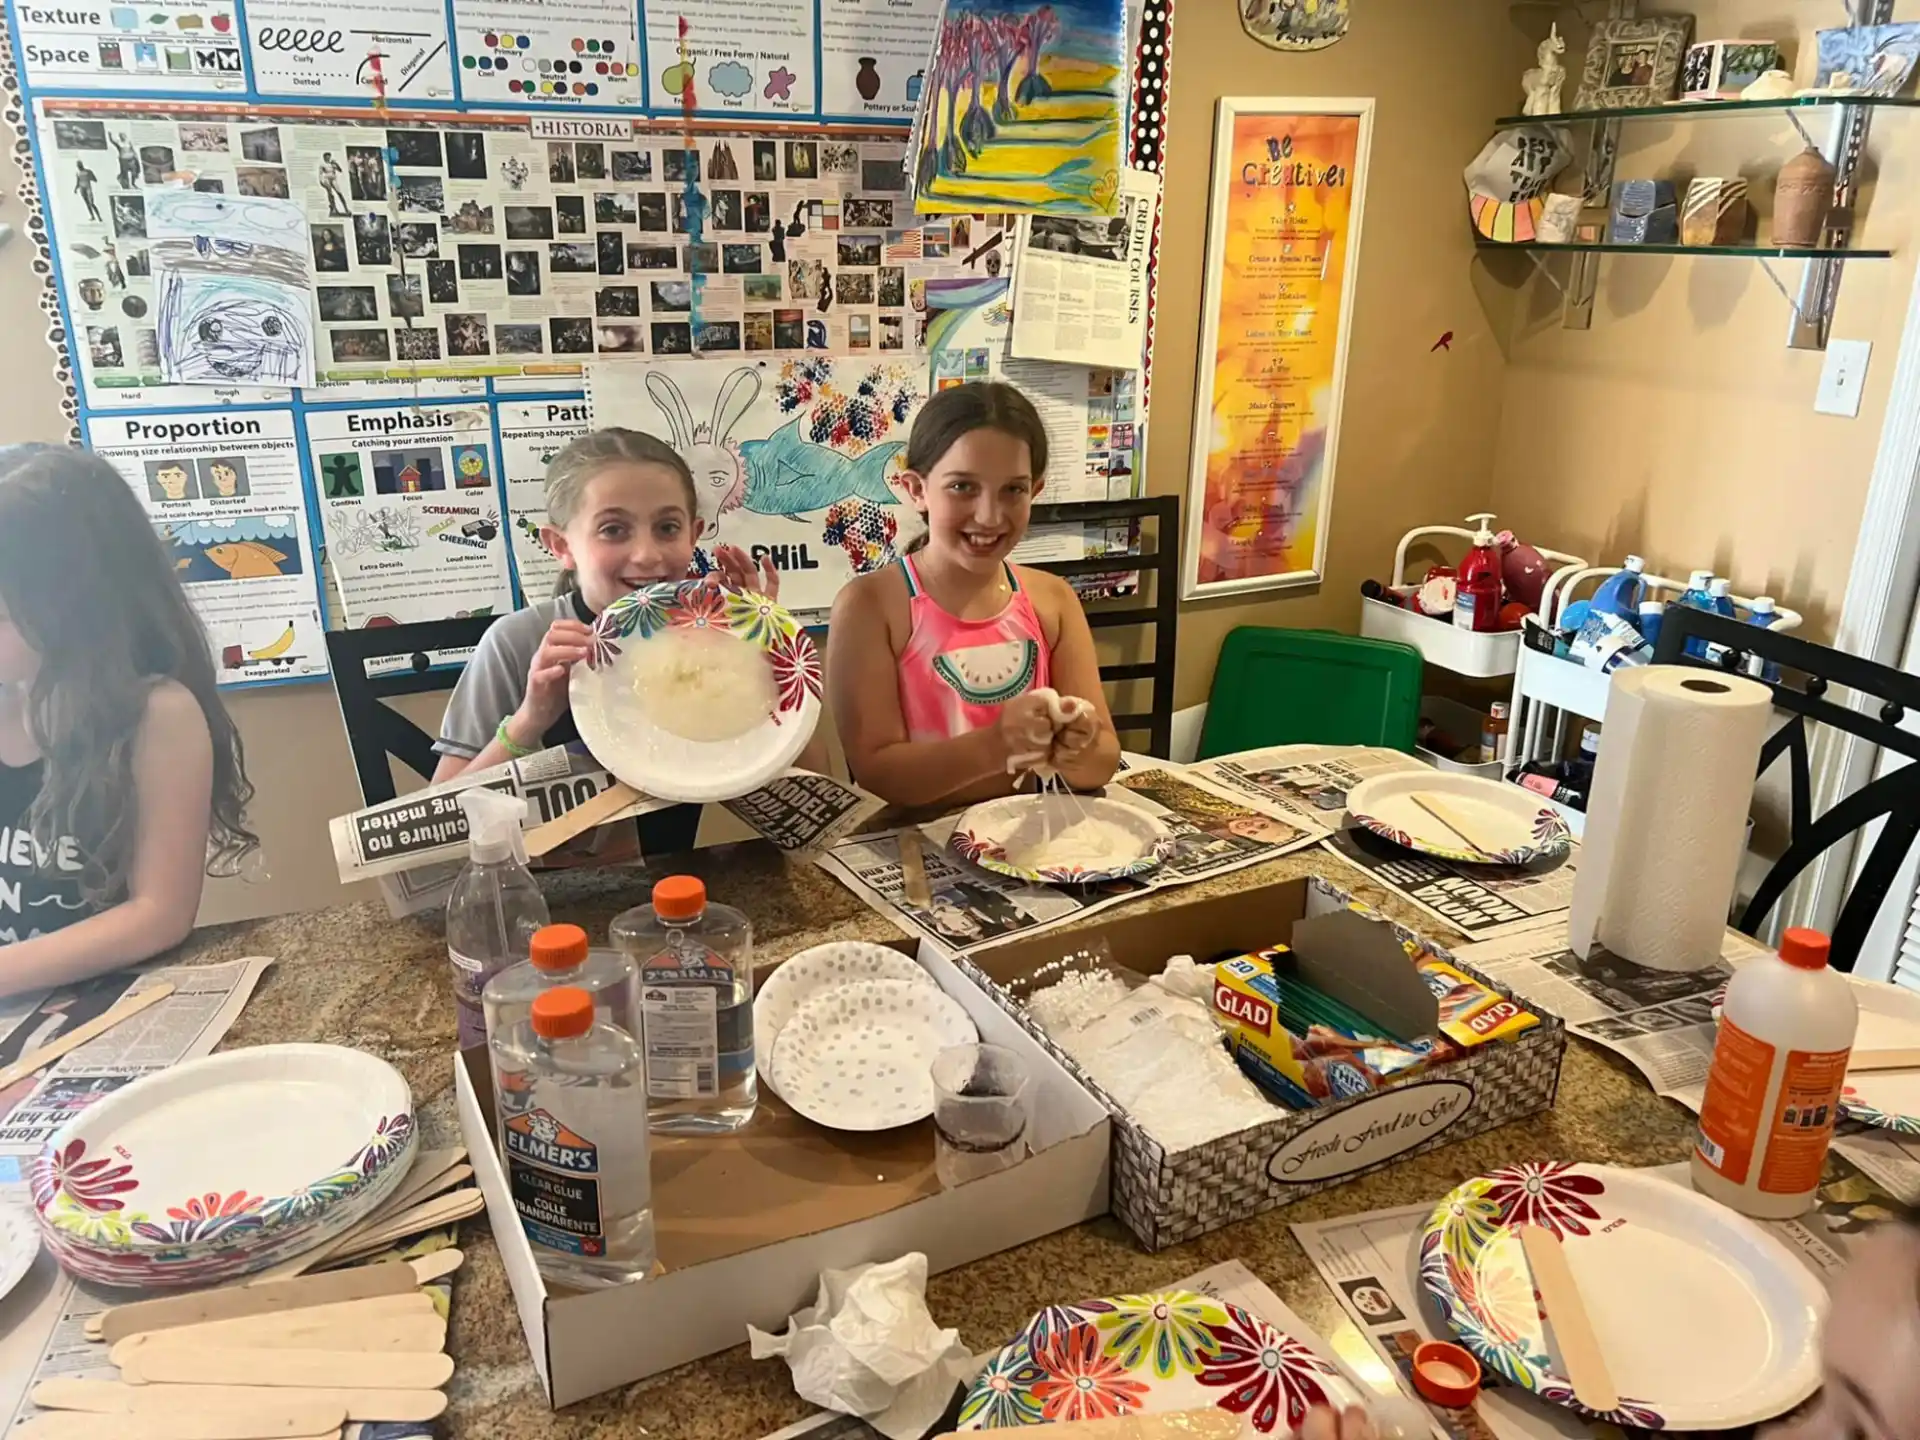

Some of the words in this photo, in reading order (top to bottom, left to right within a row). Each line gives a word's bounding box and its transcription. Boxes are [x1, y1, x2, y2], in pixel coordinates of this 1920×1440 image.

[18, 6, 101, 25] Texture
[372, 36, 412, 44] Horizontal
[27, 45, 91, 65] Space
[293, 54, 314, 64] Curly
[494, 48, 523, 57] Primary
[576, 52, 612, 61] Secondary
[714, 50, 732, 58] Free
[734, 50, 754, 59] Form
[760, 51, 789, 61] Natural
[400, 48, 426, 76] Diagonal
[293, 78, 321, 87] Dotted
[540, 73, 567, 81] Neutral
[528, 94, 582, 103] Complimentary
[723, 99, 742, 107] Cloud
[863, 103, 891, 113] Pottery
[541, 122, 622, 137] HISTORIA
[1266, 134, 1293, 162] Be
[1133, 198, 1149, 255] CREDIT
[1128, 257, 1141, 324] COURSES
[121, 391, 142, 400] Hard
[214, 388, 240, 398] Rough
[547, 404, 588, 421] Patt
[347, 409, 453, 434] Emphasis
[125, 417, 261, 443] Proportion
[502, 430, 544, 440] Repeating
[141, 448, 159, 456] size
[161, 444, 218, 456] relationship
[220, 442, 260, 452] between
[261, 441, 294, 451] objects
[352, 437, 390, 449] Catching
[392, 438, 412, 447] your
[414, 434, 454, 444] attention
[161, 500, 191, 509] Portrait
[210, 498, 246, 506] Distorted
[402, 494, 423, 502] Focus
[188, 509, 214, 518] change
[254, 505, 269, 513] look
[422, 505, 480, 516] SCREAMING!
[439, 533, 488, 549] CHEERING!
[359, 564, 378, 572] Extra
[379, 562, 403, 570] Details
[244, 667, 290, 677] Exaggerated
[361, 803, 428, 833] matter
[398, 815, 469, 845] culture
[368, 832, 393, 852] no
[1230, 960, 1254, 974] 30
[1215, 985, 1269, 1026] GLAD
[1470, 1001, 1519, 1033] GLAD
[6, 1111, 42, 1126] hat
[508, 1130, 592, 1169] ELMER'S
[1282, 1132, 1342, 1174] Fresh
[1343, 1111, 1402, 1153] Food
[519, 1172, 552, 1193] CLEAR
[553, 1183, 583, 1200] GLUE
[534, 1197, 567, 1216] COLLE
[514, 1197, 598, 1233] TRANSPARENTE
